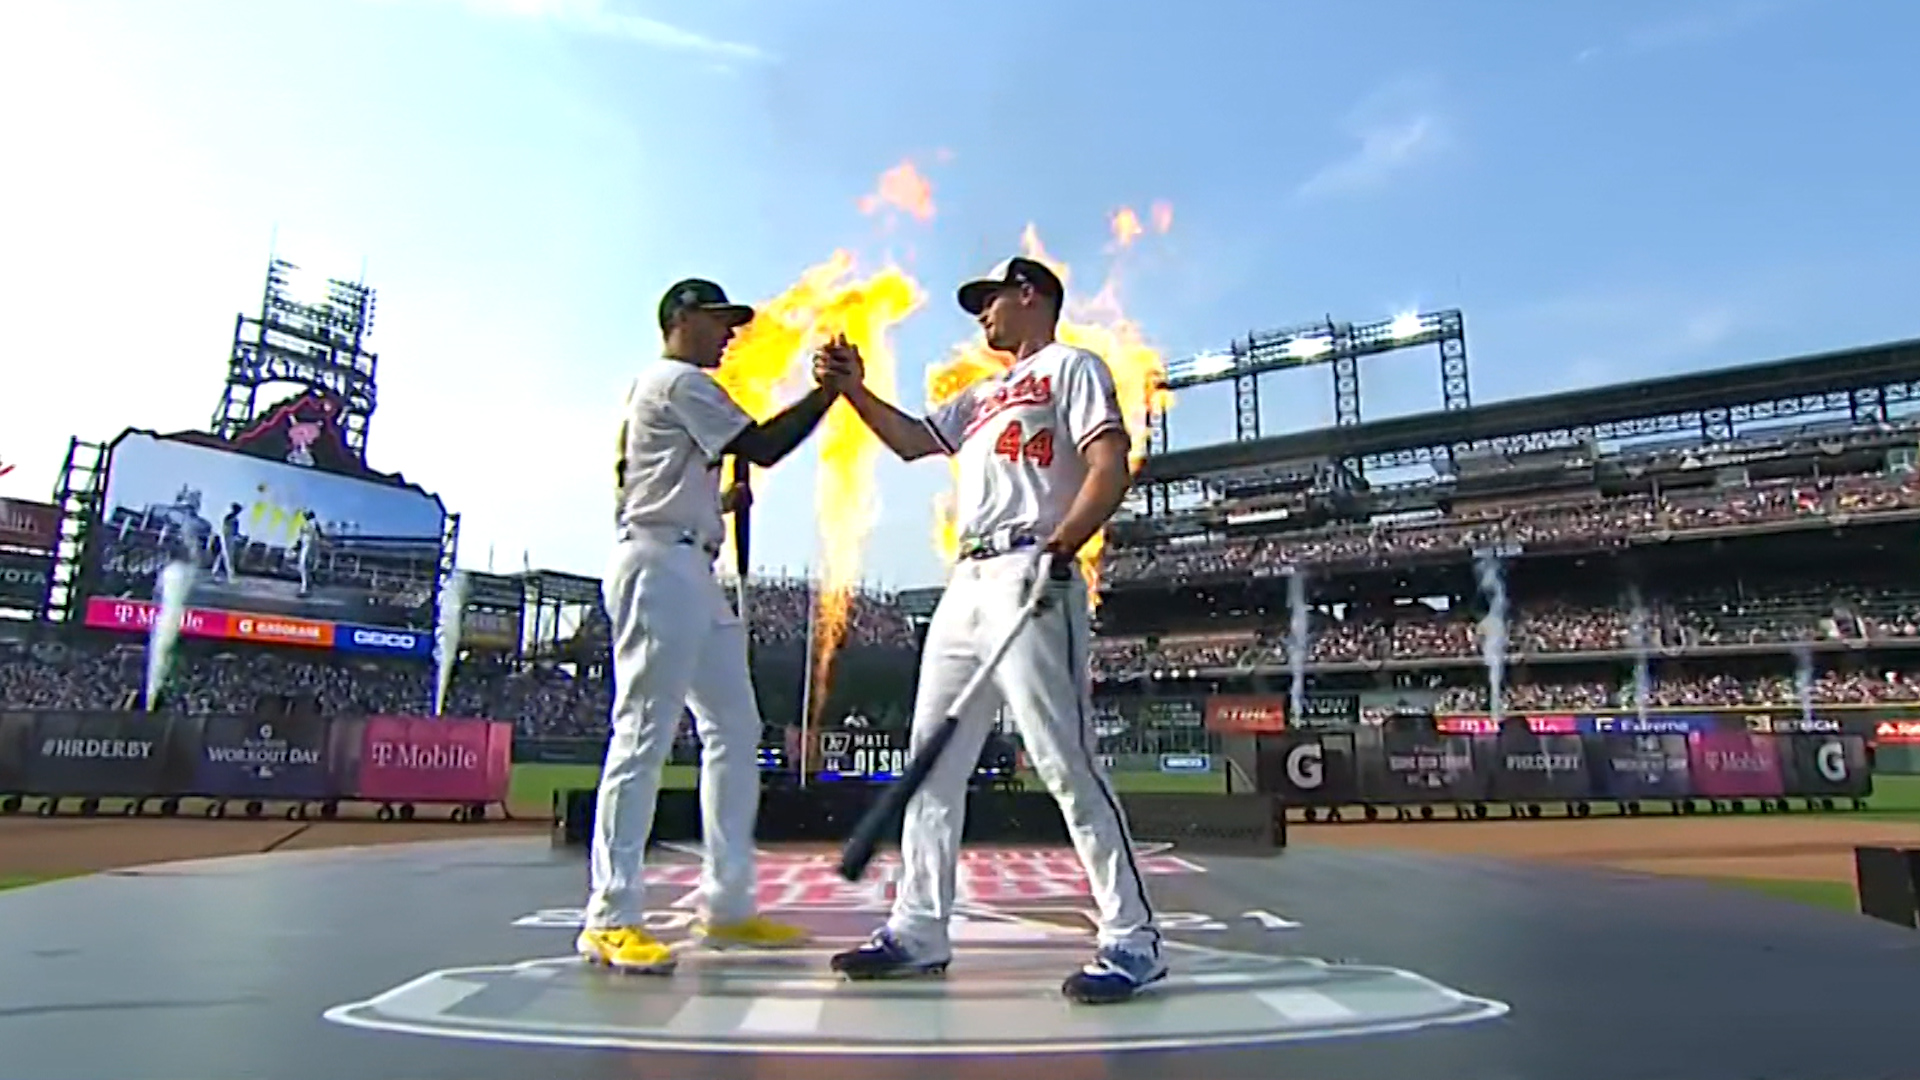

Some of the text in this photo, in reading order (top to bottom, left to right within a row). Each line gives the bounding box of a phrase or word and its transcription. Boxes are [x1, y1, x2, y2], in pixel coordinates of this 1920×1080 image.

[994, 419, 1054, 468] 44
[42, 739, 153, 759] #HRDERBY
[207, 746, 319, 763] WORKOUT DAY
[396, 743, 477, 770] Mobile
[1817, 742, 1847, 781] G
[1286, 743, 1322, 790] G
